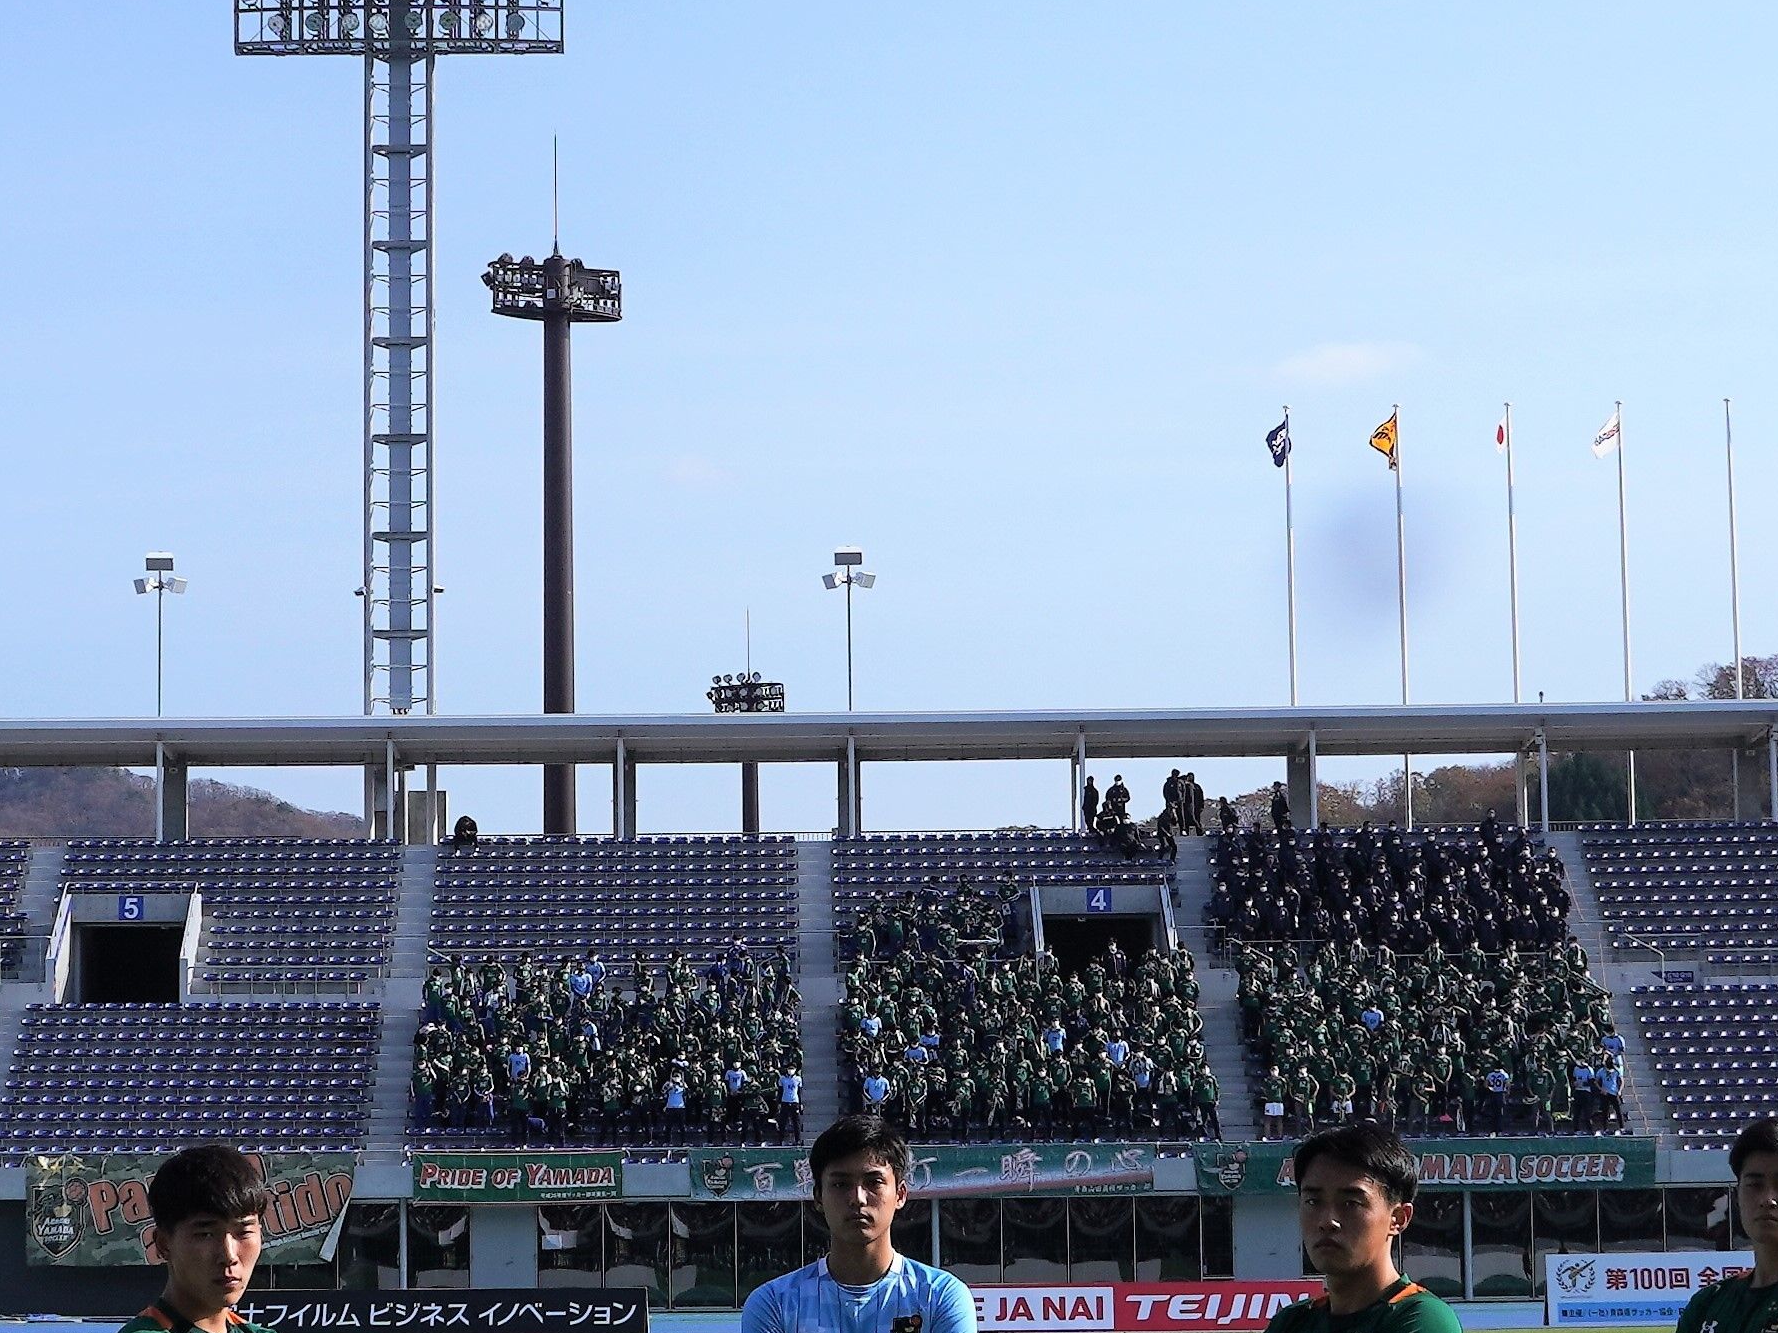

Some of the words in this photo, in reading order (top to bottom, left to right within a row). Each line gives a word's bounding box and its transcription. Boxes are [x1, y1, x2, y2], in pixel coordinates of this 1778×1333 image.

[124, 898, 139, 919] 5
[1091, 889, 1107, 910] 4
[419, 1162, 487, 1189] PRIDE
[490, 1168, 522, 1189] OF
[525, 1163, 616, 1189] YAMADA
[1518, 1153, 1625, 1183] SOCCER
[1605, 1267, 1691, 1291] 第100回
[369, 1301, 470, 1327] ビジネス
[478, 1301, 637, 1327] イノベーション
[995, 1296, 1035, 1322] JA
[1042, 1295, 1105, 1322] NAI
